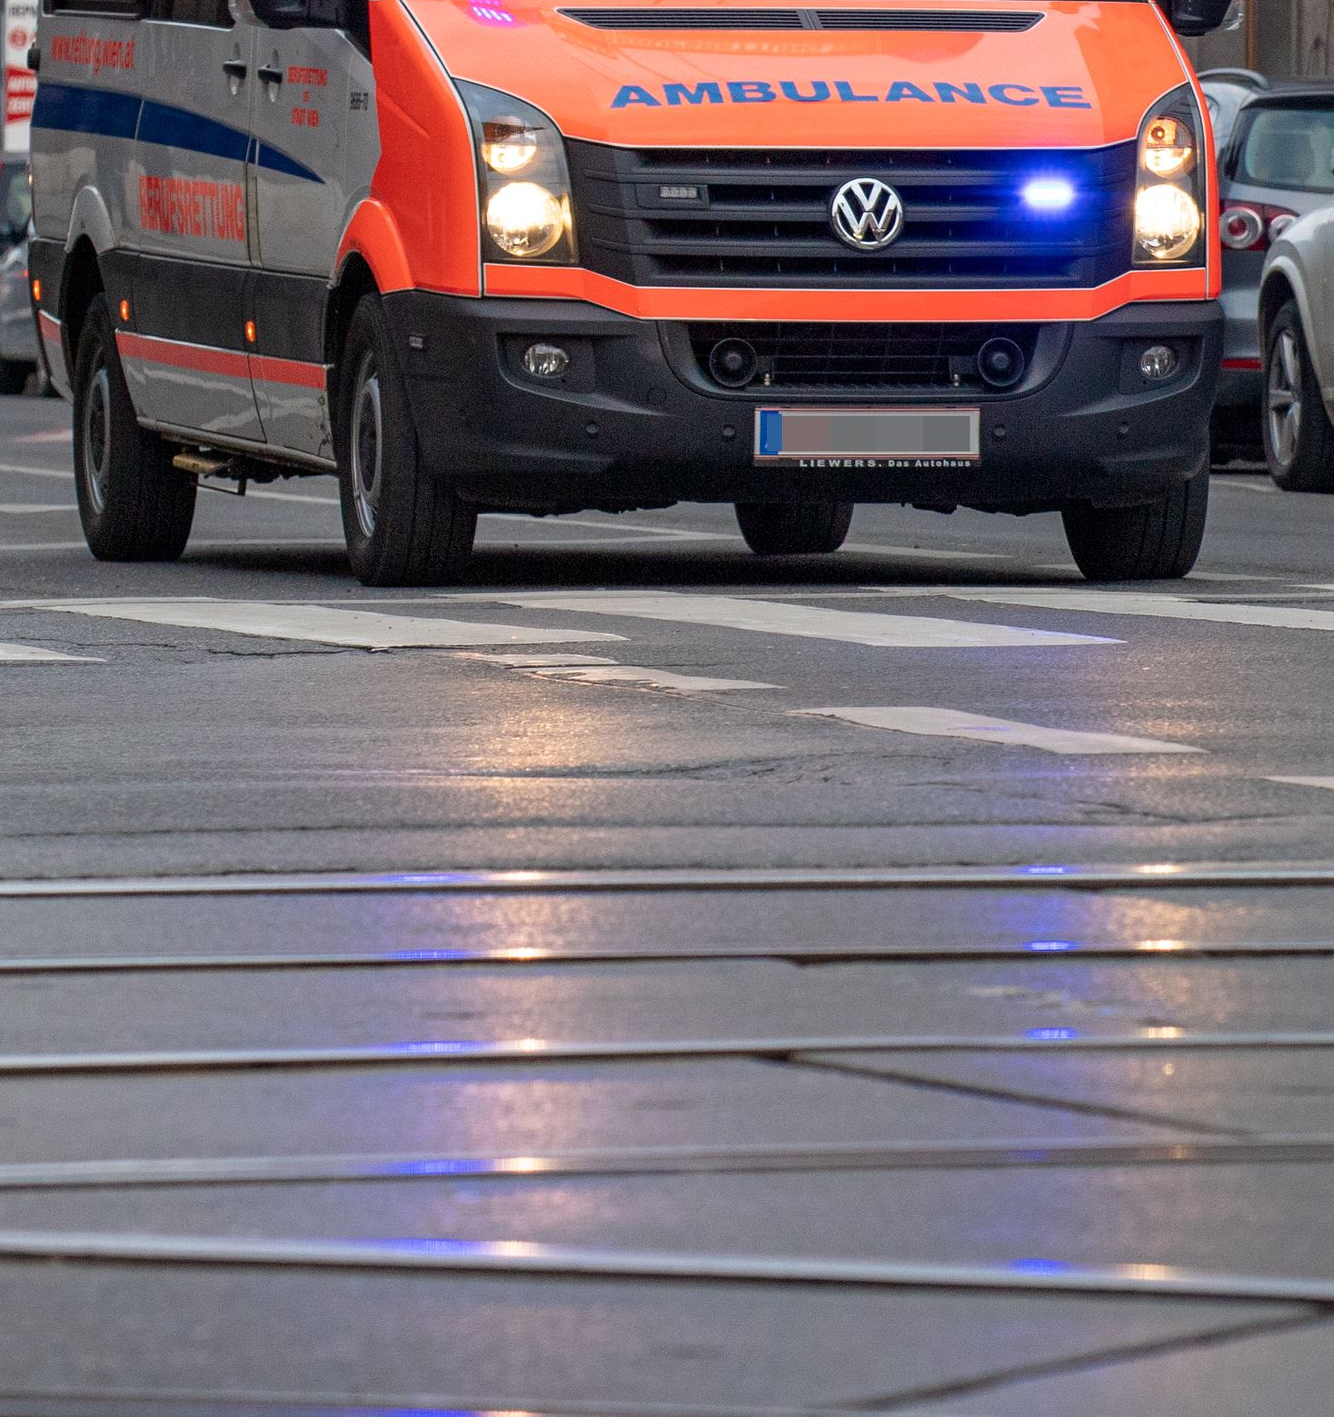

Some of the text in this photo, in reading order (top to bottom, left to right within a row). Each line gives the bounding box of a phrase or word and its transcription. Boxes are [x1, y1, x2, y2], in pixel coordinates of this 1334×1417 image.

[610, 80, 1094, 110] AMBULANCE
[138, 175, 245, 242] BERUFSRETTUNG
[799, 459, 971, 468] LIEWERS. Das Autohaus
